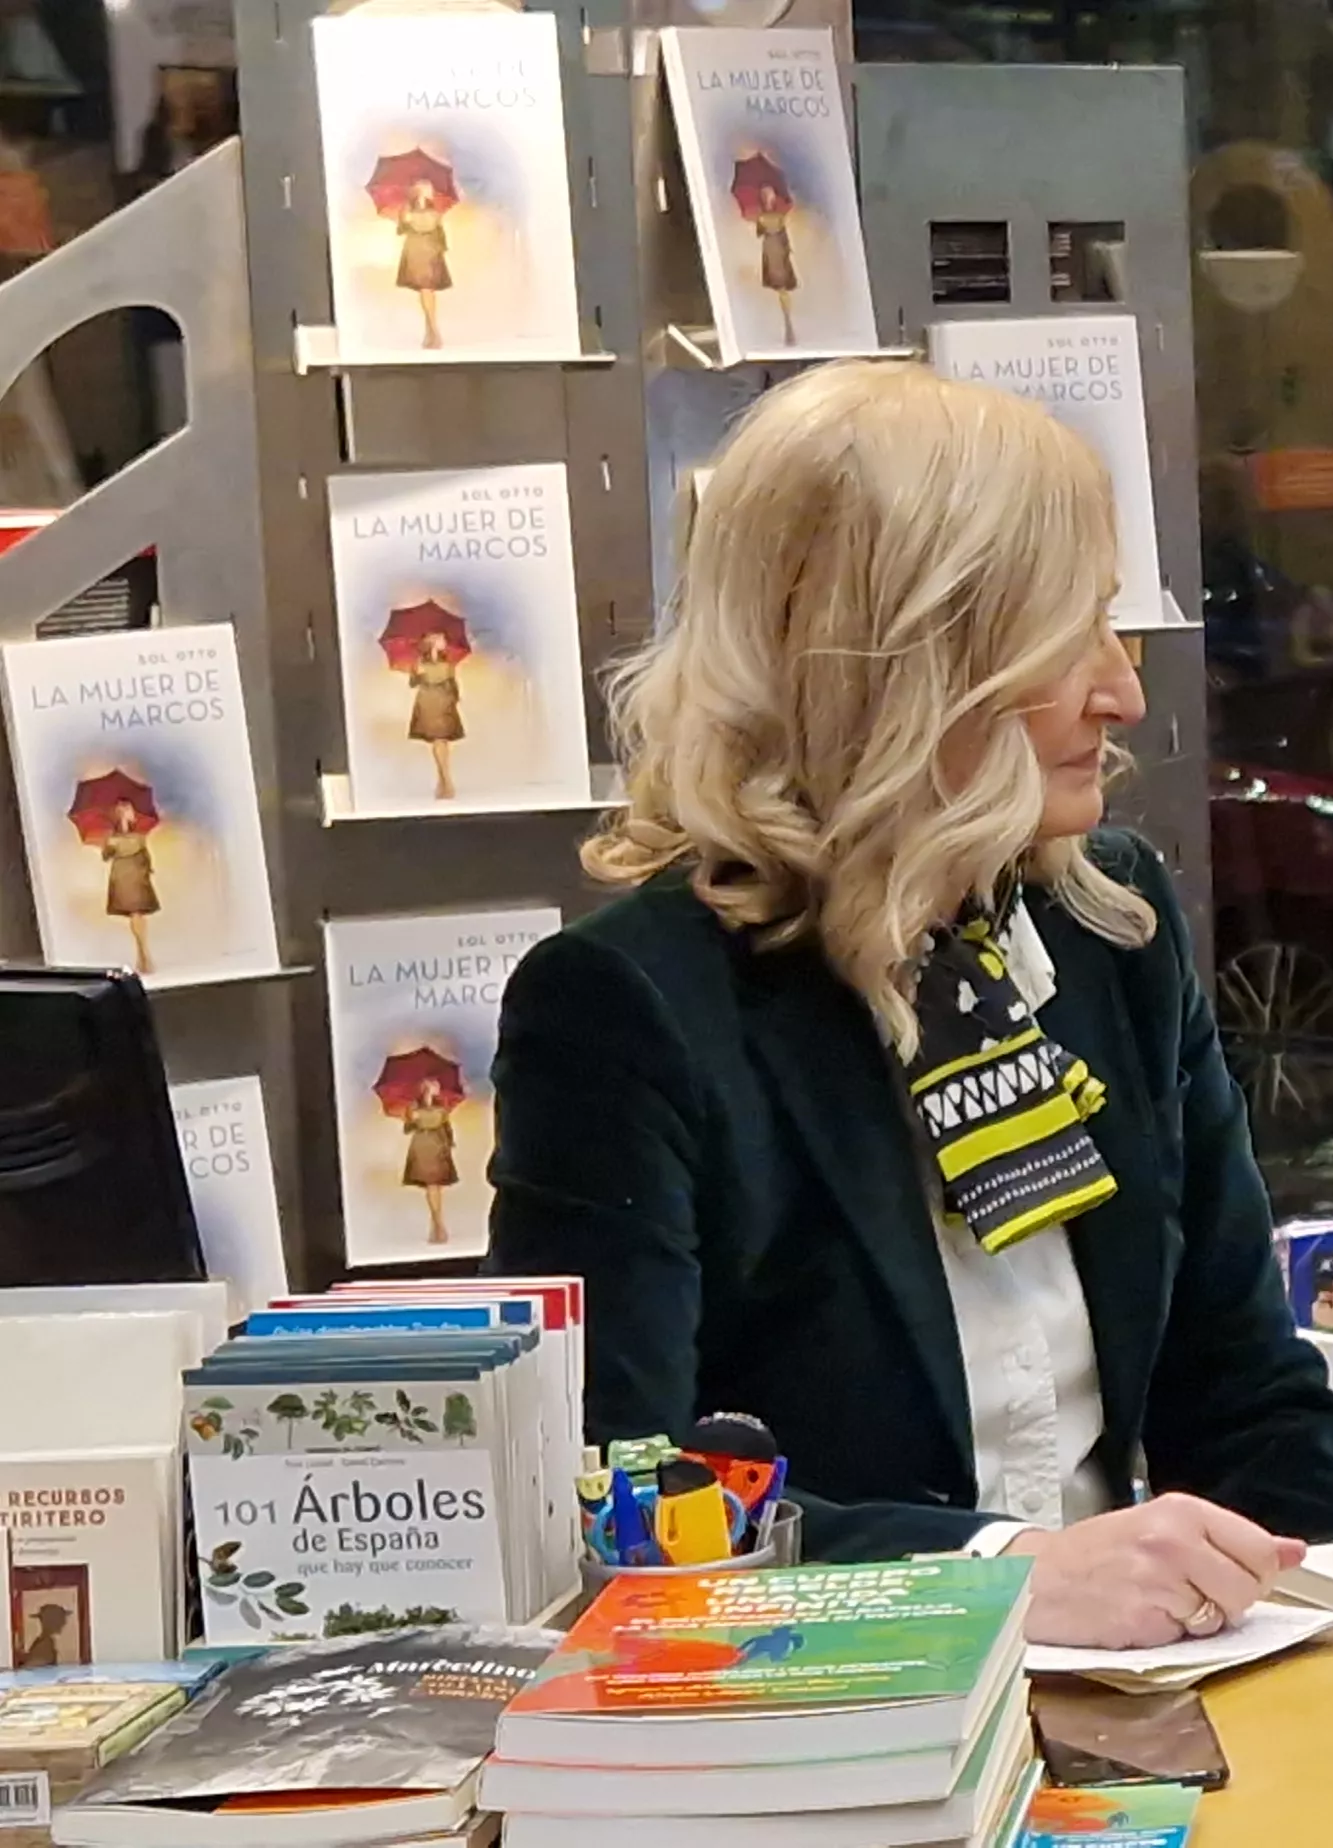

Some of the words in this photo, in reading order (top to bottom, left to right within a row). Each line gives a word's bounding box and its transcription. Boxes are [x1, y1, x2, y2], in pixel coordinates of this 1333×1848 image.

[405, 87, 537, 110] MARCOS
[994, 355, 1080, 379] MUJER
[1088, 354, 1120, 376] DE
[353, 516, 389, 539] LA
[400, 509, 496, 537] MUJER
[507, 506, 546, 531] DE
[419, 534, 548, 562] MARCOS
[31, 685, 69, 710] LA
[79, 673, 175, 704] MUJER
[184, 669, 220, 693] DE
[100, 697, 225, 731] MARCOS
[349, 964, 386, 987] LA
[395, 956, 492, 983] MUJER
[414, 982, 501, 1010] MARC
[209, 1122, 246, 1148] DE
[189, 1150, 251, 1179] COS
[7, 1487, 126, 1507] RECURSOS
[213, 1499, 278, 1526] 101
[291, 1472, 486, 1524] Árboles
[291, 1528, 328, 1554] de
[337, 1526, 440, 1557] España
[296, 1562, 329, 1577] que
[333, 1558, 363, 1577] hay
[368, 1561, 400, 1576] que
[405, 1557, 474, 1572] conocer
